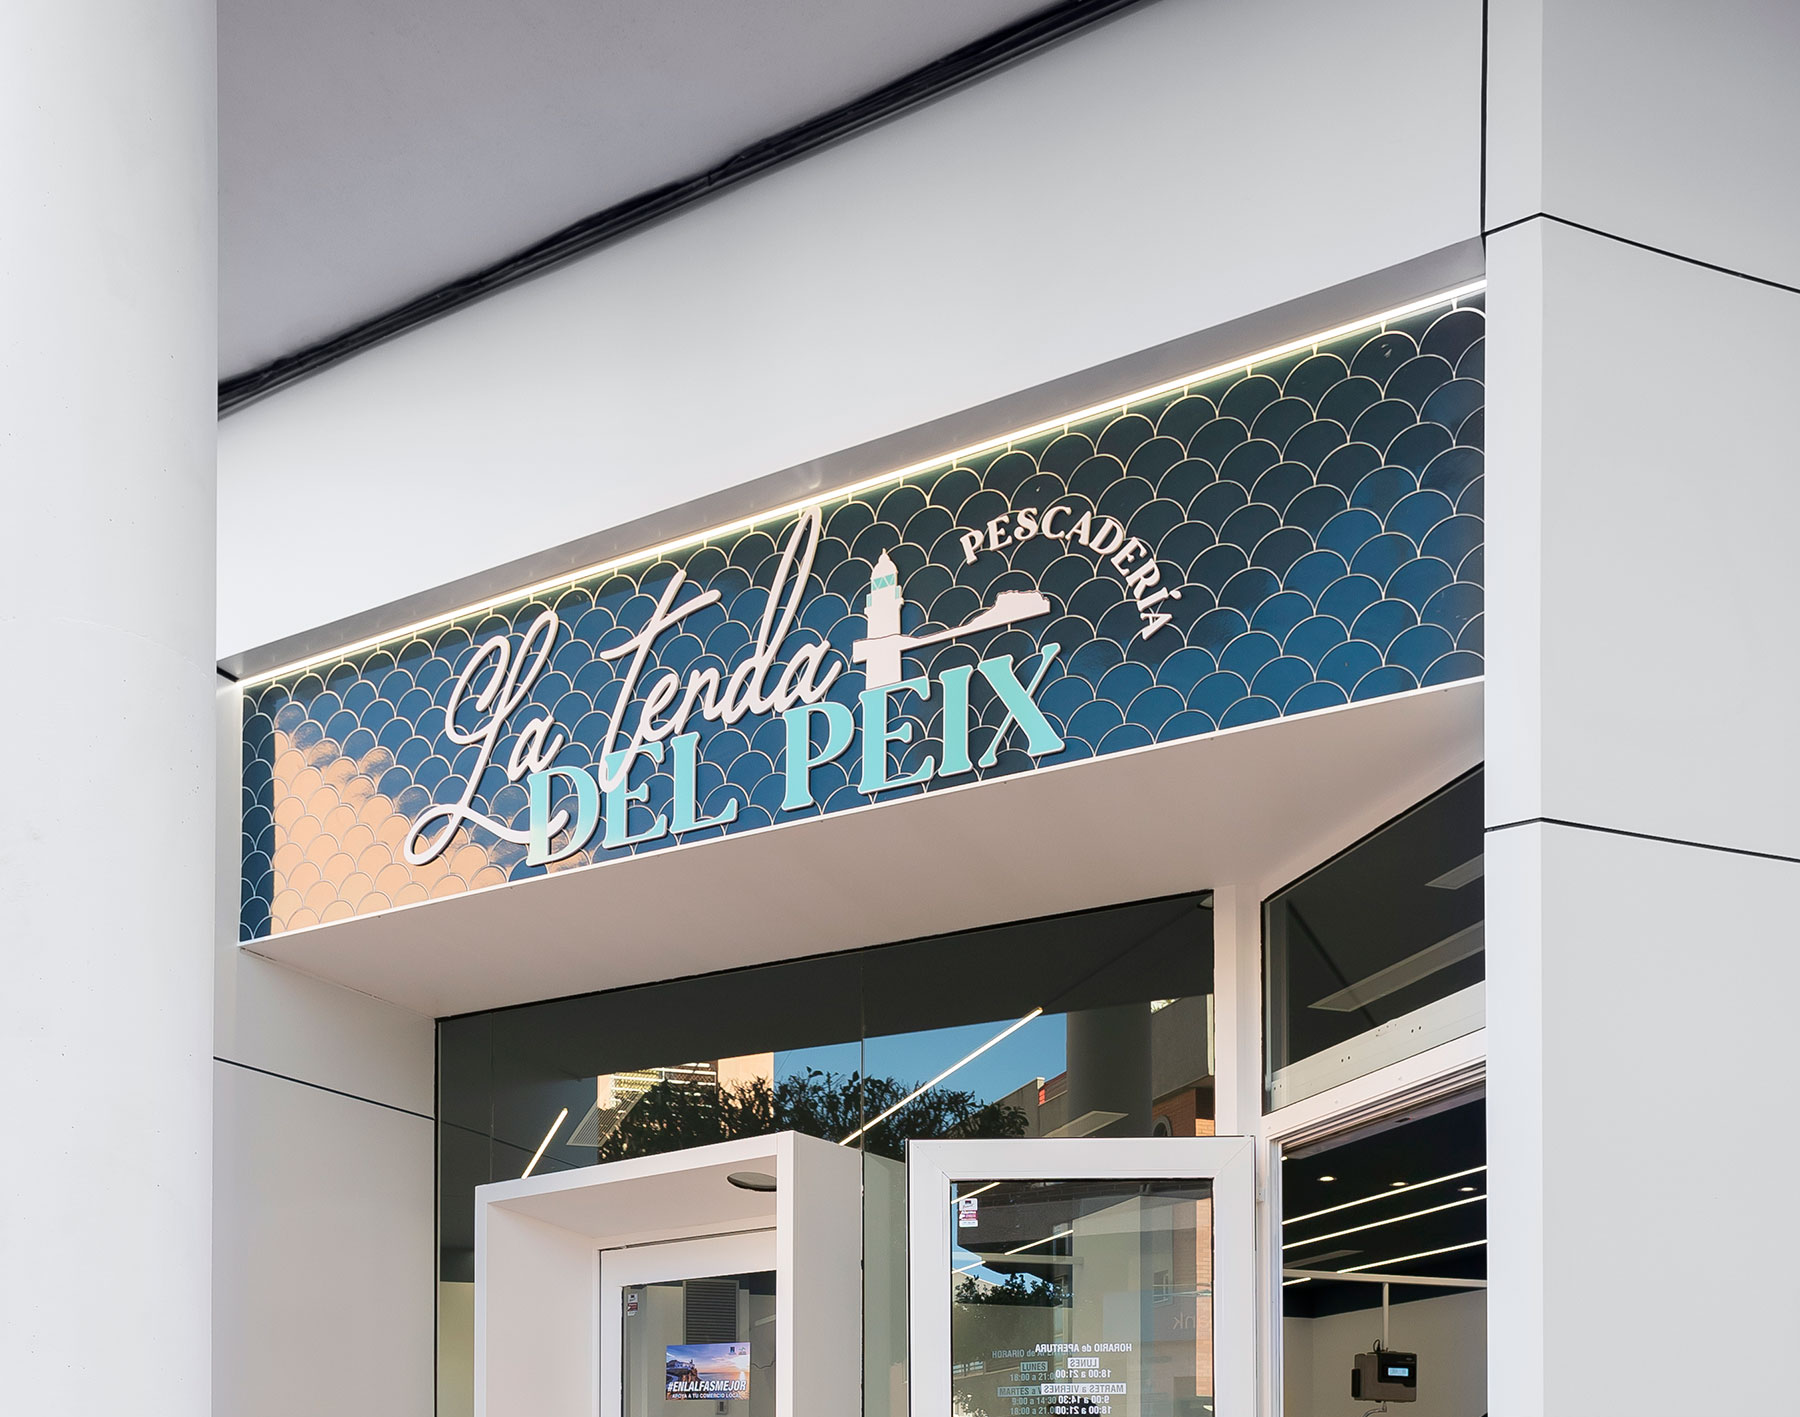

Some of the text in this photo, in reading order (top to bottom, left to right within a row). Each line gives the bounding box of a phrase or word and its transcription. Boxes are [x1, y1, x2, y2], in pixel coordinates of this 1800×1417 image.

[960, 506, 1183, 641] PESCADERÍA
[403, 609, 567, 866] La
[525, 643, 1066, 867] DEL PEIX
[667, 1380, 747, 1392] #ENLALFASMEJOR
[1021, 1362, 1047, 1371] LUNES
